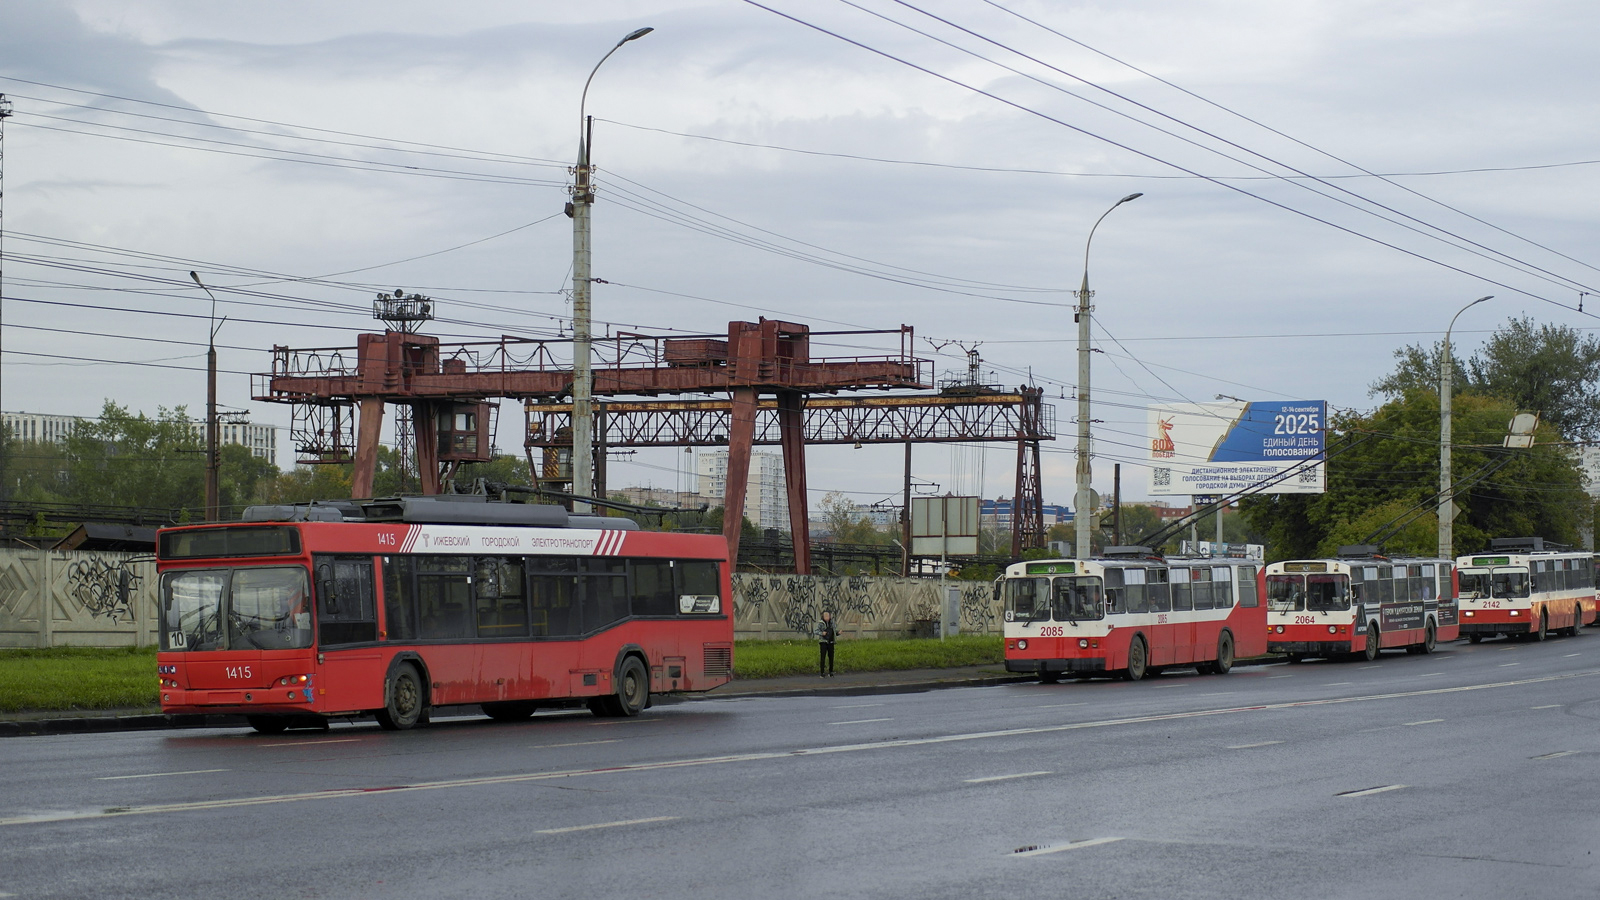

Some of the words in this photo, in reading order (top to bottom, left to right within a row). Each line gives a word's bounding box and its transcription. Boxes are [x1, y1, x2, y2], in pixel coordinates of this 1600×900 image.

[1274, 414, 1319, 435] 2025
[1152, 439, 1165, 451] 80
[1263, 436, 1296, 447] ЕДИНЫЙ
[1298, 437, 1319, 447] ДЕНЬ
[1263, 448, 1319, 457] голосования
[1195, 481, 1228, 489] ГОРОДСКОЙ
[1229, 481, 1246, 489] ДУМЫ
[376, 532, 396, 546] 1415
[433, 535, 471, 546] ИЖЕВСКИЙ
[481, 536, 520, 548] ГОРОДСКОЙ
[531, 537, 593, 549] ЭЛЕКТРОТРАНСПОРТ
[1006, 612, 1012, 621] 9
[1157, 614, 1168, 624] 2085
[1295, 615, 1315, 624] 2064
[1040, 626, 1064, 637] 2085
[171, 632, 184, 647] 10
[225, 666, 252, 679] 1415
